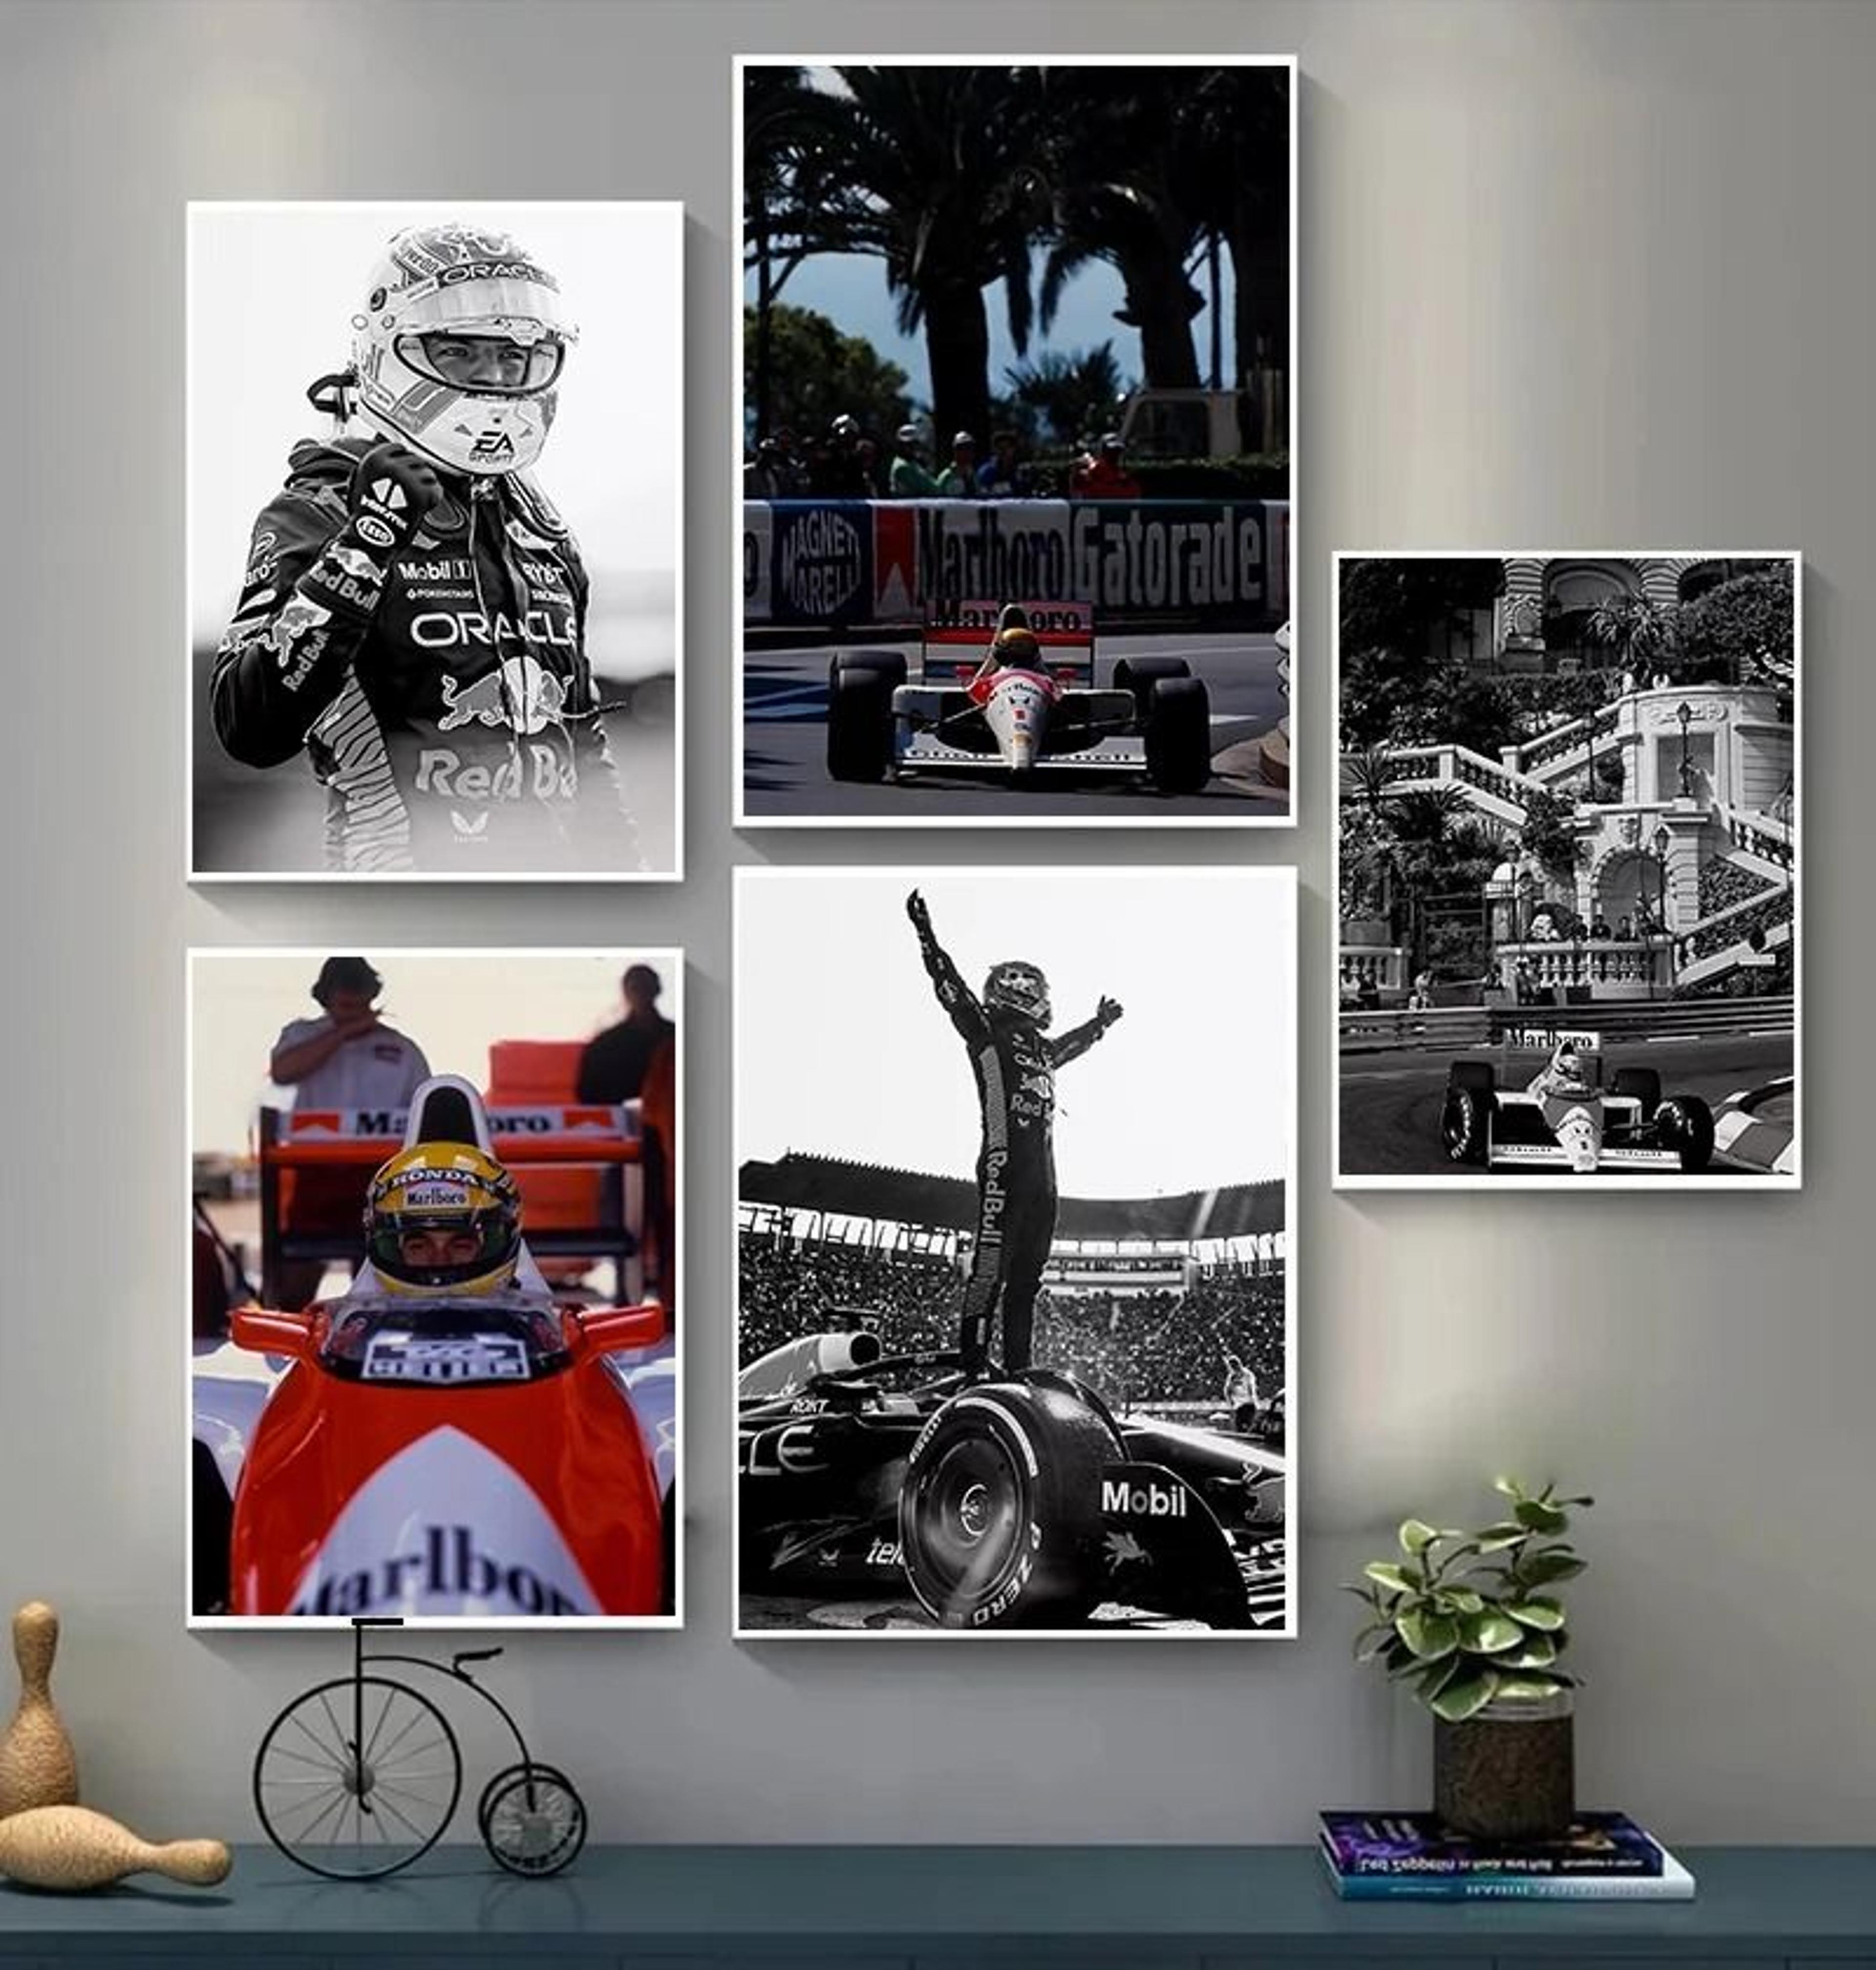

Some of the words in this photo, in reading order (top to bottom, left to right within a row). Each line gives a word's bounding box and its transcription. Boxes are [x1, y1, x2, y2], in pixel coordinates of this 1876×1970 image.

[471, 431, 514, 453] EA
[398, 560, 450, 580] Mobil
[918, 507, 1065, 601] Marlboro
[1075, 506, 1261, 606] Gatorade
[339, 577, 381, 611] Bull
[929, 600, 1081, 628] Maroro
[415, 740, 523, 799] Red
[392, 1169, 479, 1187] HONDA
[407, 1188, 467, 1205] Marlboro
[1102, 1481, 1186, 1517] Mobil
